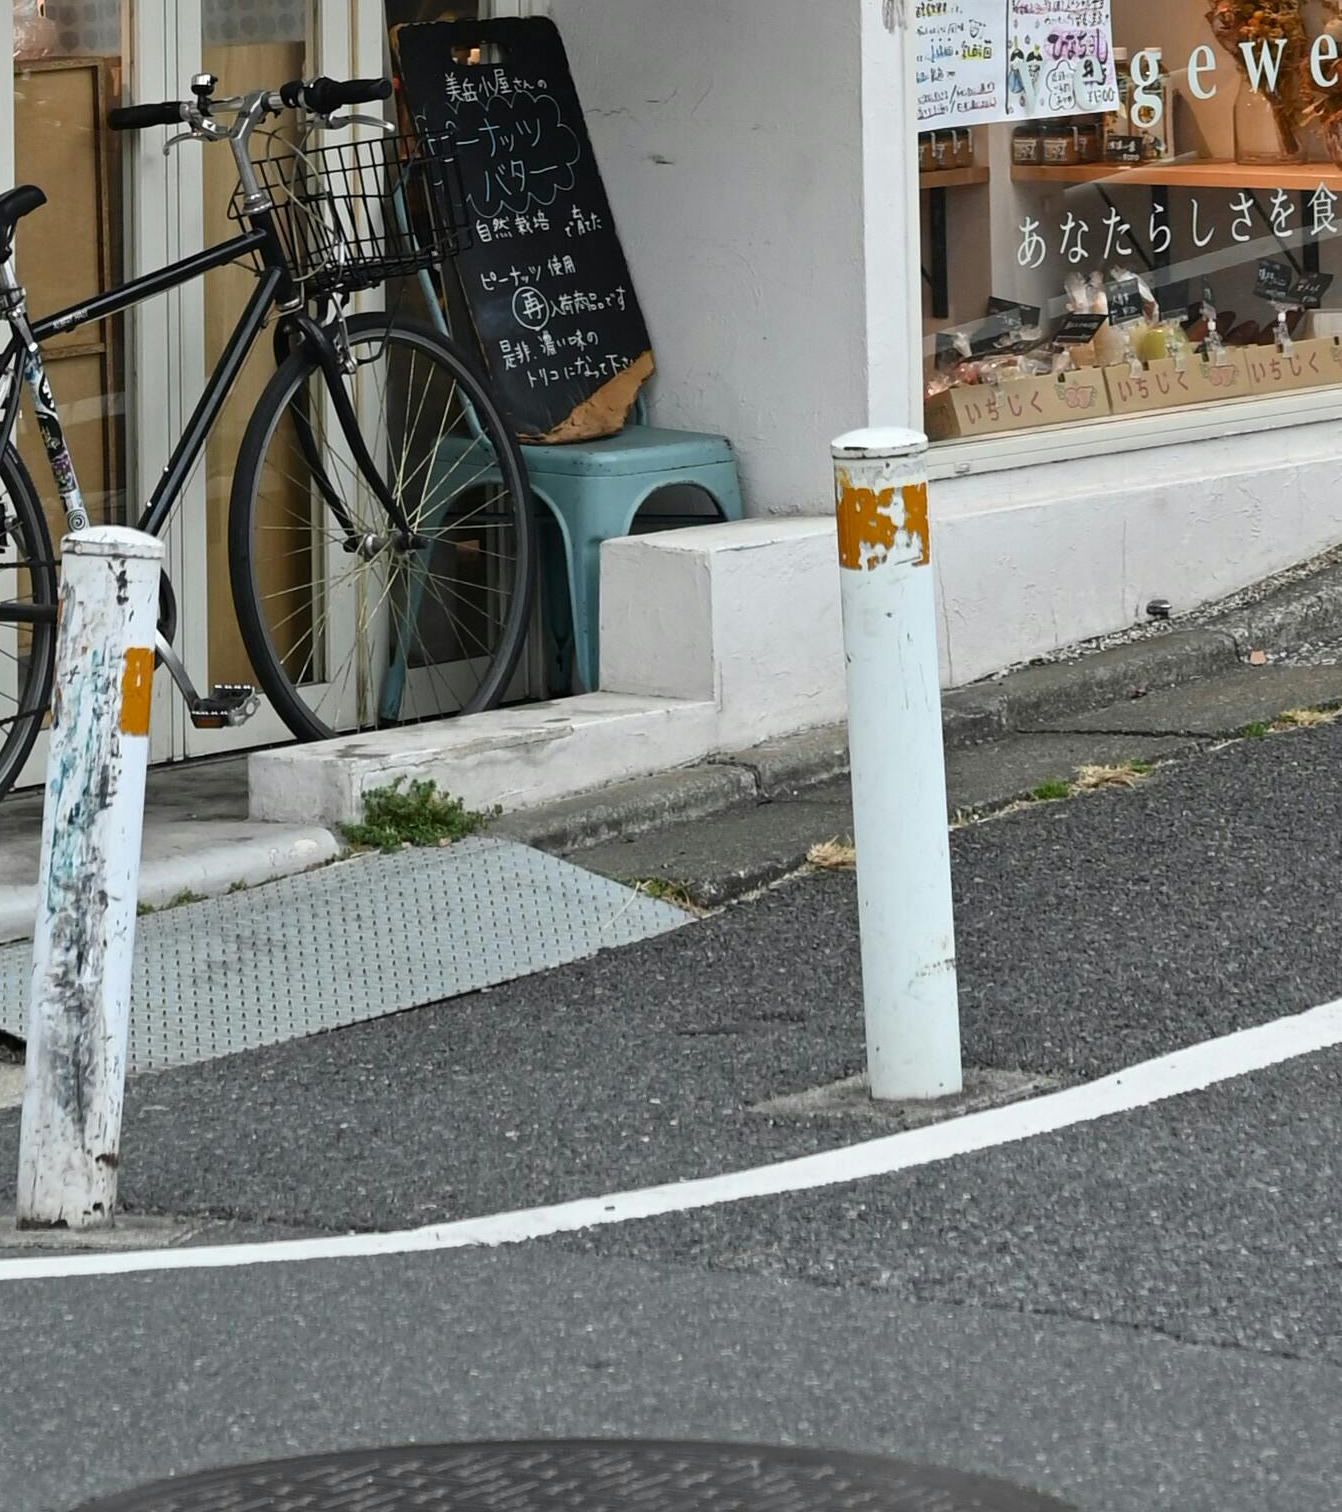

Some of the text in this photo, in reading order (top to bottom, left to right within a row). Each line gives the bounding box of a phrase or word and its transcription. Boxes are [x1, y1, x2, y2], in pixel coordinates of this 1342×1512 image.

[484, 160, 559, 203] バター
[547, 254, 577, 277] 使用
[1117, 367, 1190, 404] いちじく
[1250, 350, 1321, 385] いちじく
[965, 389, 1045, 425] いちじく
